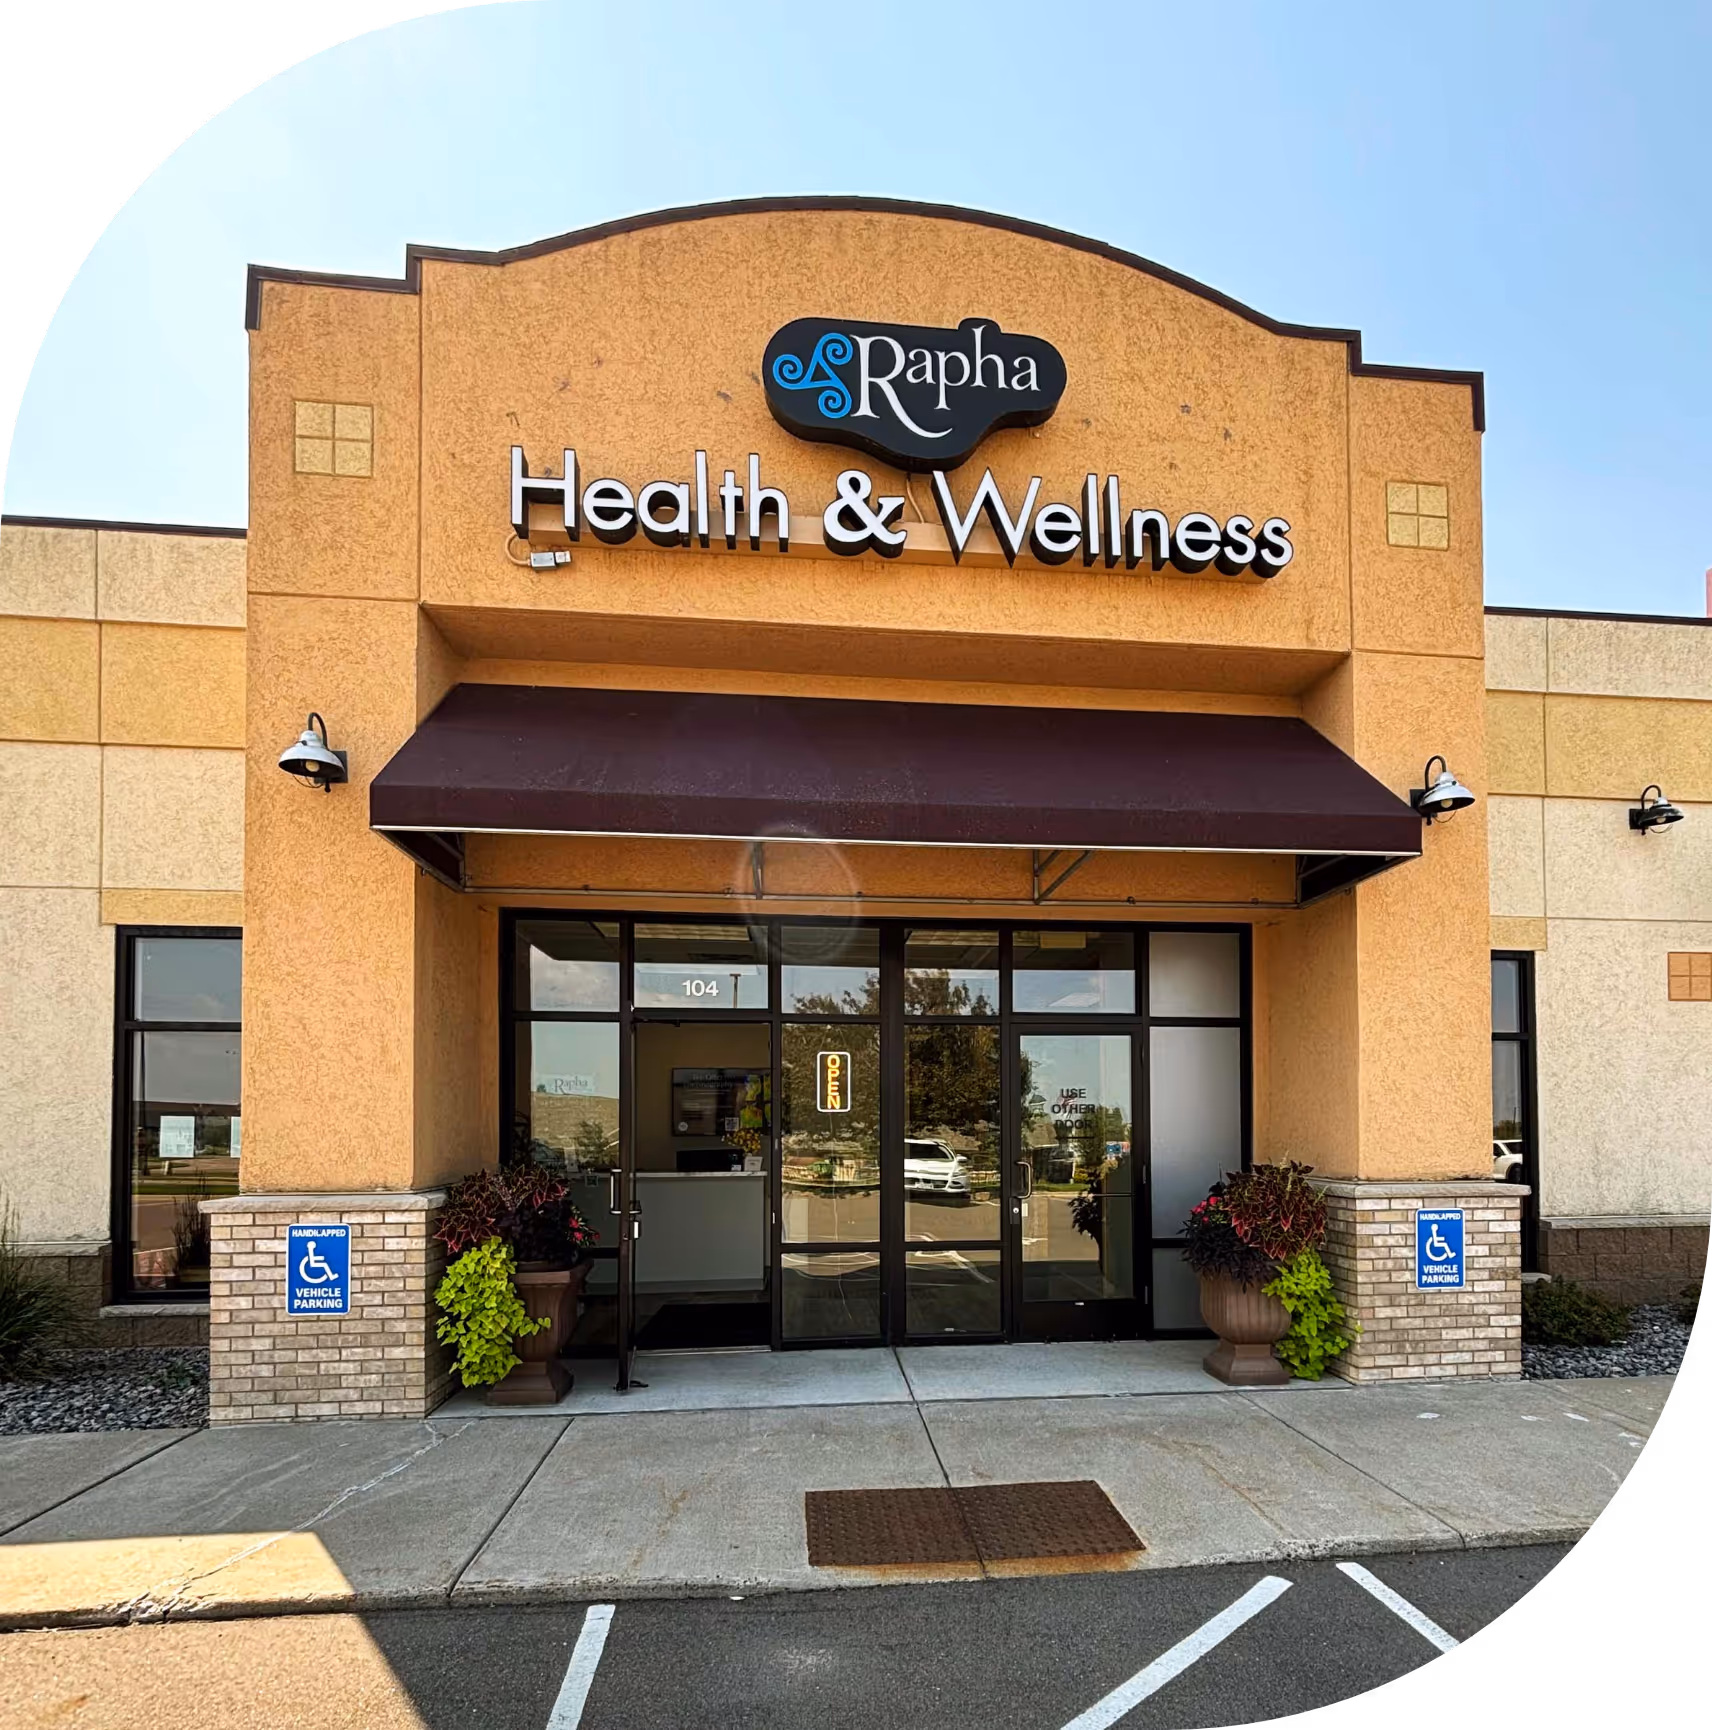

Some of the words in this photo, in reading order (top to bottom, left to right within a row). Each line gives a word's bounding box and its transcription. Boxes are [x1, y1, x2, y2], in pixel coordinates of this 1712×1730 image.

[851, 325, 1042, 439] Rapha
[511, 446, 789, 541] Health
[824, 468, 908, 548] &
[932, 469, 1294, 568] Wellness
[682, 979, 719, 997] 104
[827, 1054, 841, 1110] OPEN
[1061, 1088, 1087, 1098] USE
[1052, 1104, 1095, 1114] OTHER
[1055, 1119, 1092, 1129] DOOR
[1420, 1213, 1461, 1221] HANDICAPPED
[292, 1228, 346, 1237] HANDICAPPED
[1423, 1265, 1458, 1274] VEHICLE
[1422, 1275, 1459, 1284] PARKING
[295, 1287, 342, 1297] VEHICLE
[294, 1299, 343, 1309] PARKING
